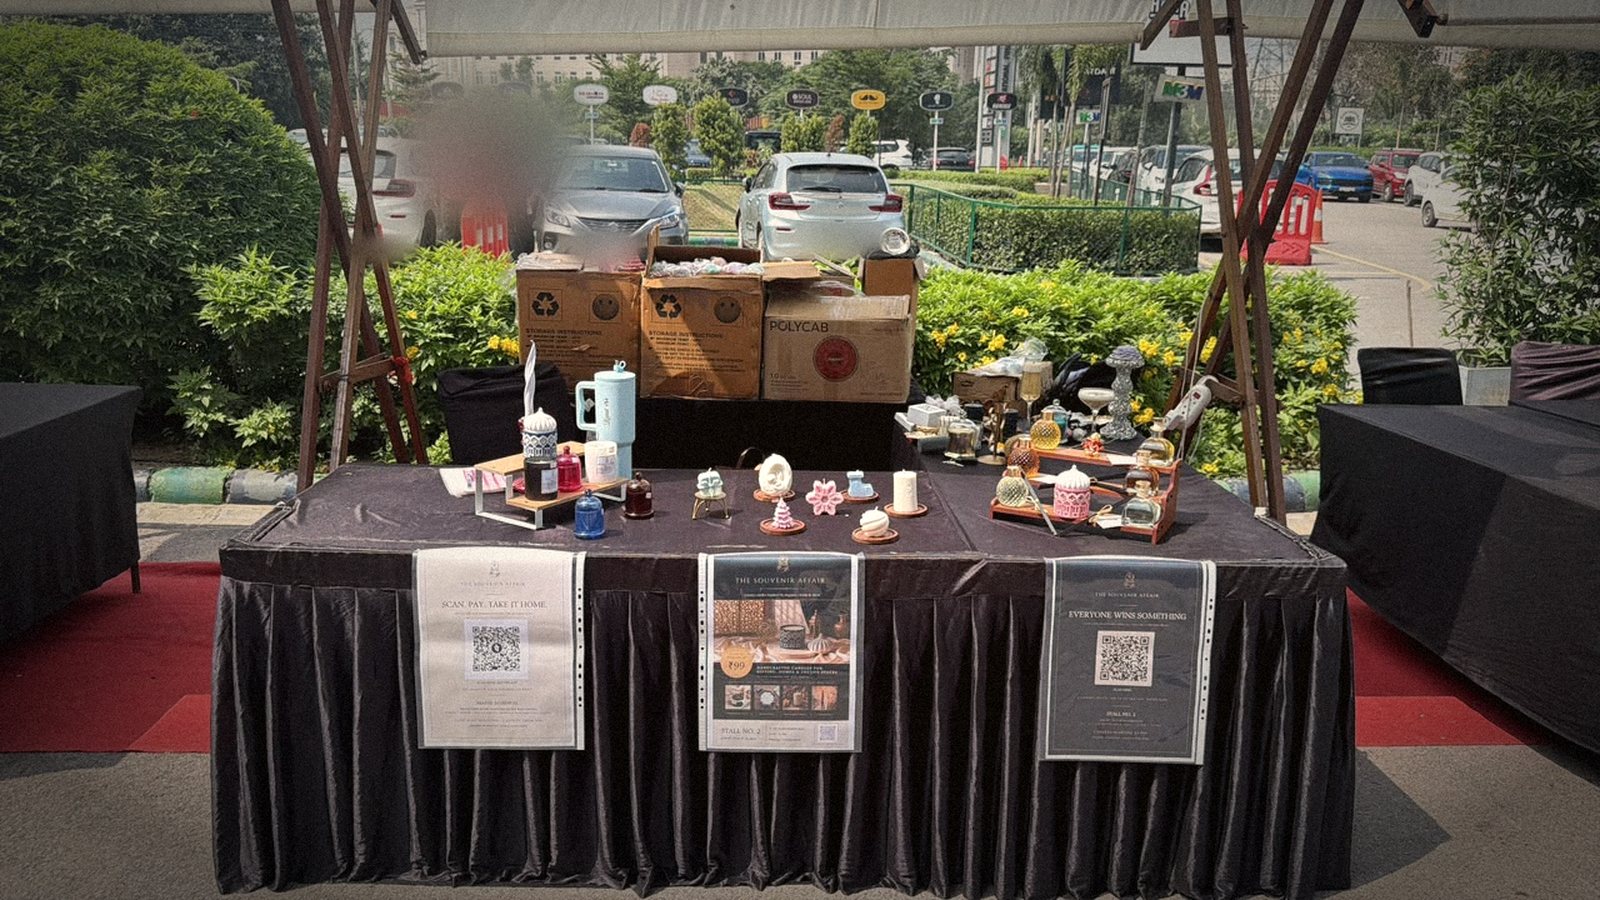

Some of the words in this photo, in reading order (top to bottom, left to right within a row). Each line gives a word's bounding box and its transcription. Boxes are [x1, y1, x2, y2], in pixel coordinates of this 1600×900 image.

[769, 320, 829, 333] POLYCAB
[489, 600, 508, 608] TAKE
[510, 600, 518, 608] IT
[1068, 610, 1112, 619] EVERYONE
[1113, 611, 1136, 620] WINS
[1137, 612, 1187, 621] SOMETHING
